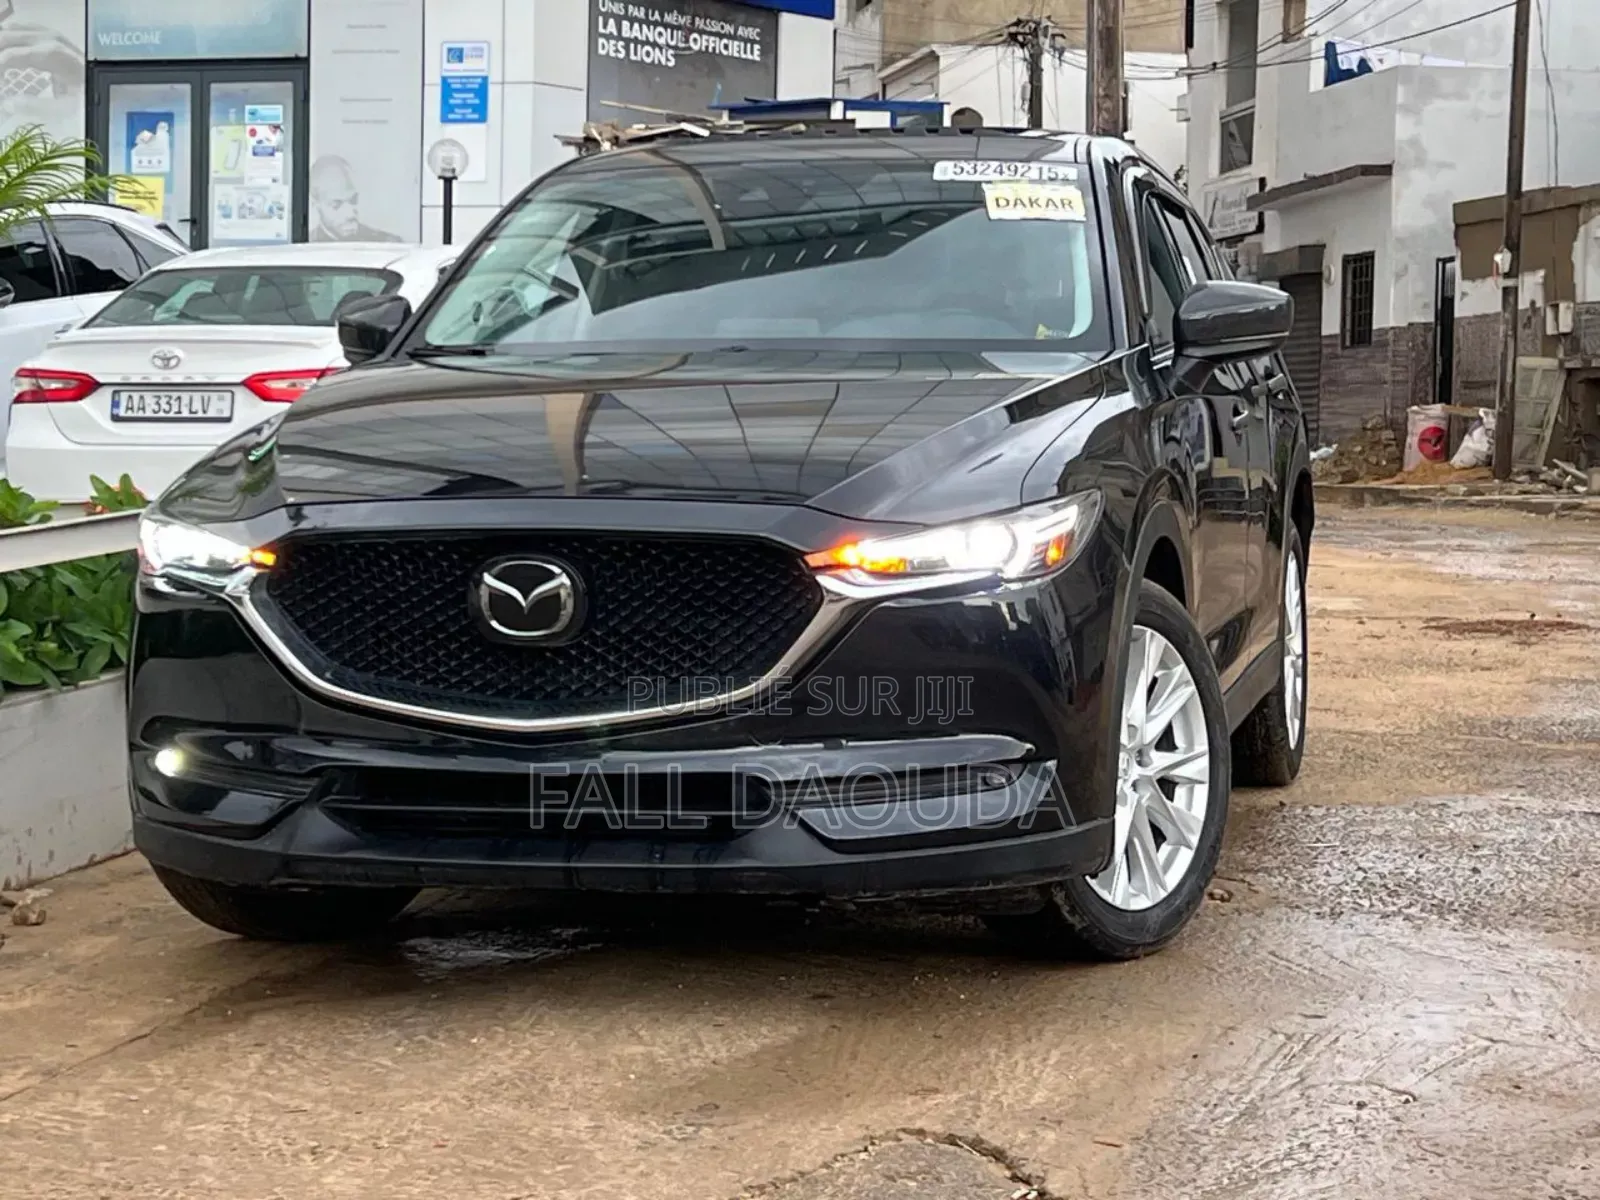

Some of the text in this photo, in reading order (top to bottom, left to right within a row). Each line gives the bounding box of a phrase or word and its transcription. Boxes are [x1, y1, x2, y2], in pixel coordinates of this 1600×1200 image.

[598, 0, 626, 17] UNIS
[628, 6, 646, 21] PAR
[648, 8, 661, 23] LA
[694, 16, 735, 36] PASSION
[737, 25, 761, 41] AVEC
[97, 30, 162, 46] WELCOME
[597, 38, 676, 67] DES LIONS
[598, 15, 617, 36] LA
[688, 32, 761, 62] OFFICIELLE
[994, 196, 1074, 210] DAKAR
